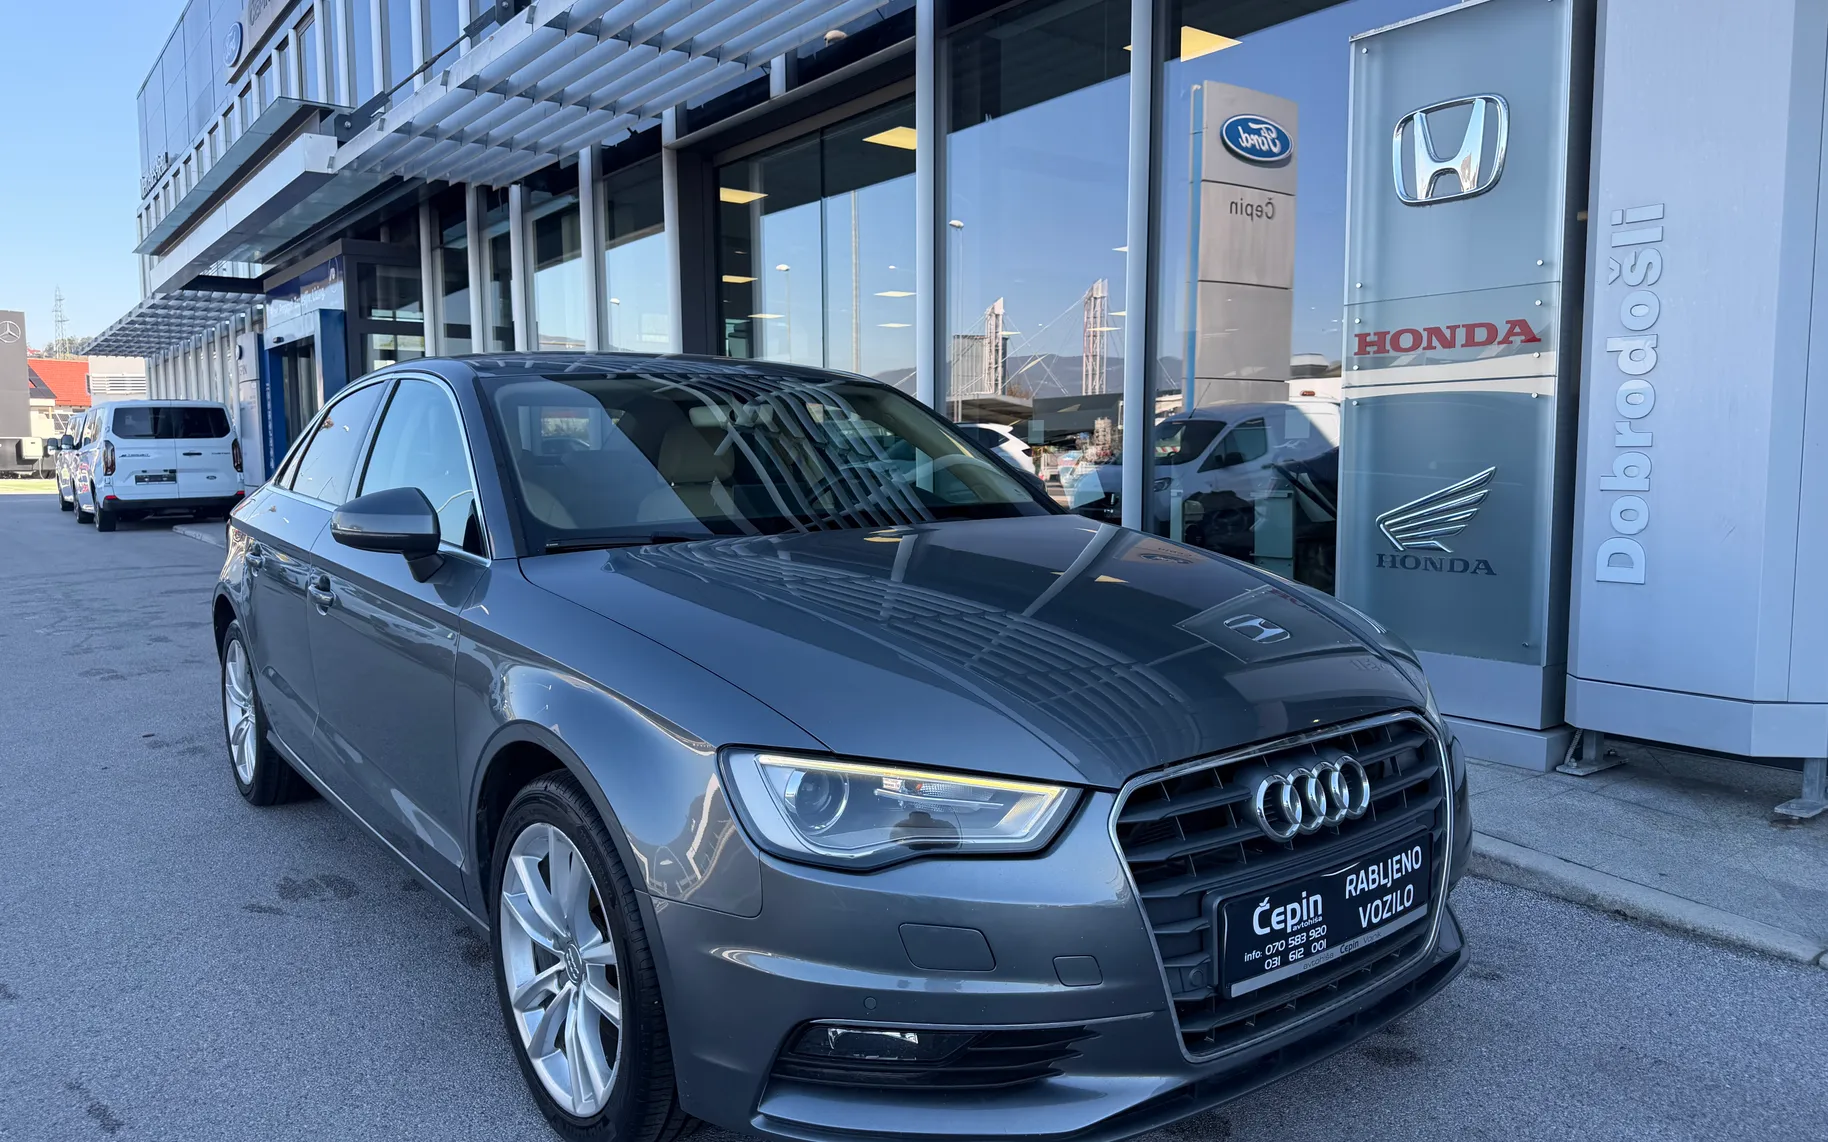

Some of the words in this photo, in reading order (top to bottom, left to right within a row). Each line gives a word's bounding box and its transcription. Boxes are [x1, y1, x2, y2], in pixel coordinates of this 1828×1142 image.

[1354, 319, 1542, 356] HONDA
[1595, 203, 1665, 585] Dobrodošli
[1376, 553, 1497, 576] HONDA
[1345, 845, 1422, 899] RABLJENO
[1253, 891, 1323, 935] Čepin
[1292, 916, 1323, 931] avtohiša
[1359, 884, 1414, 928] VOZILO
[1244, 950, 1263, 962] info:
[1265, 940, 1286, 955] 070
[1288, 932, 1307, 948] 583
[1308, 924, 1327, 940] 920
[1264, 955, 1281, 970] 031
[1288, 947, 1304, 962] 612
[1311, 938, 1327, 953] 001
